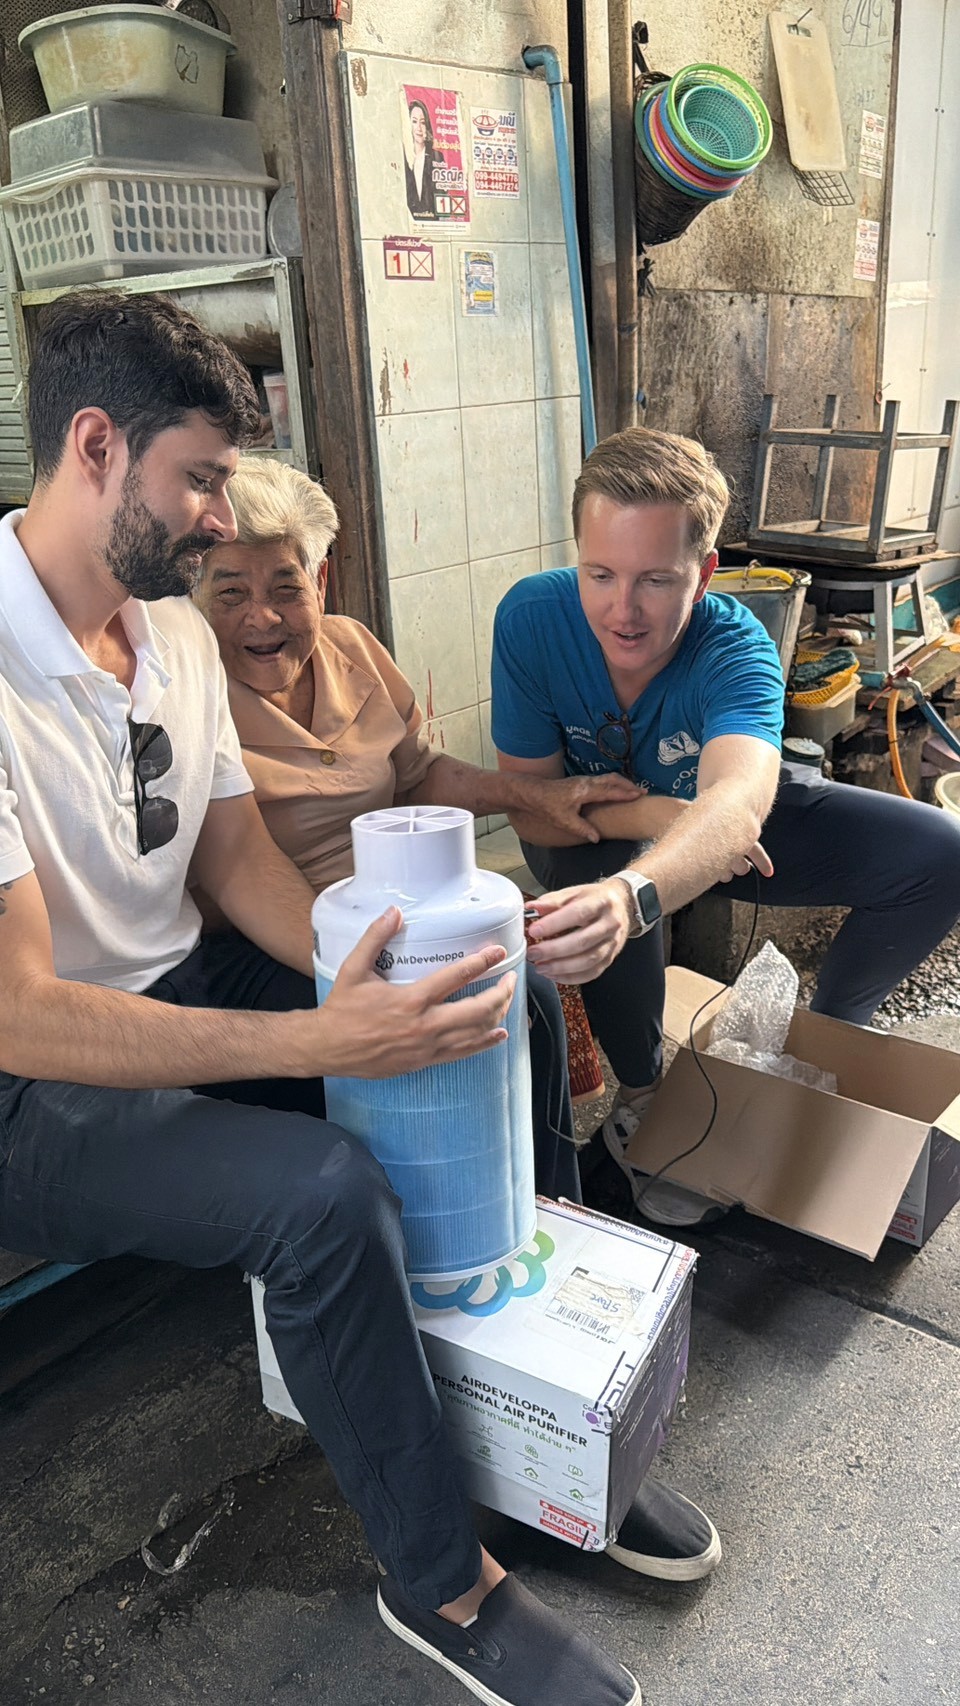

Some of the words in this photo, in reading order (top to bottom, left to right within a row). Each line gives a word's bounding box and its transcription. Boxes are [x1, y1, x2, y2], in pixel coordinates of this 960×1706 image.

[393, 252, 401, 274] 1
[396, 951, 465, 965] AirDeveloppa
[433, 1373, 501, 1410] PERSONAL
[503, 1405, 525, 1420] AIR
[528, 1414, 588, 1448] PURIFIER
[461, 1375, 558, 1423] AIRDEVELOPPA
